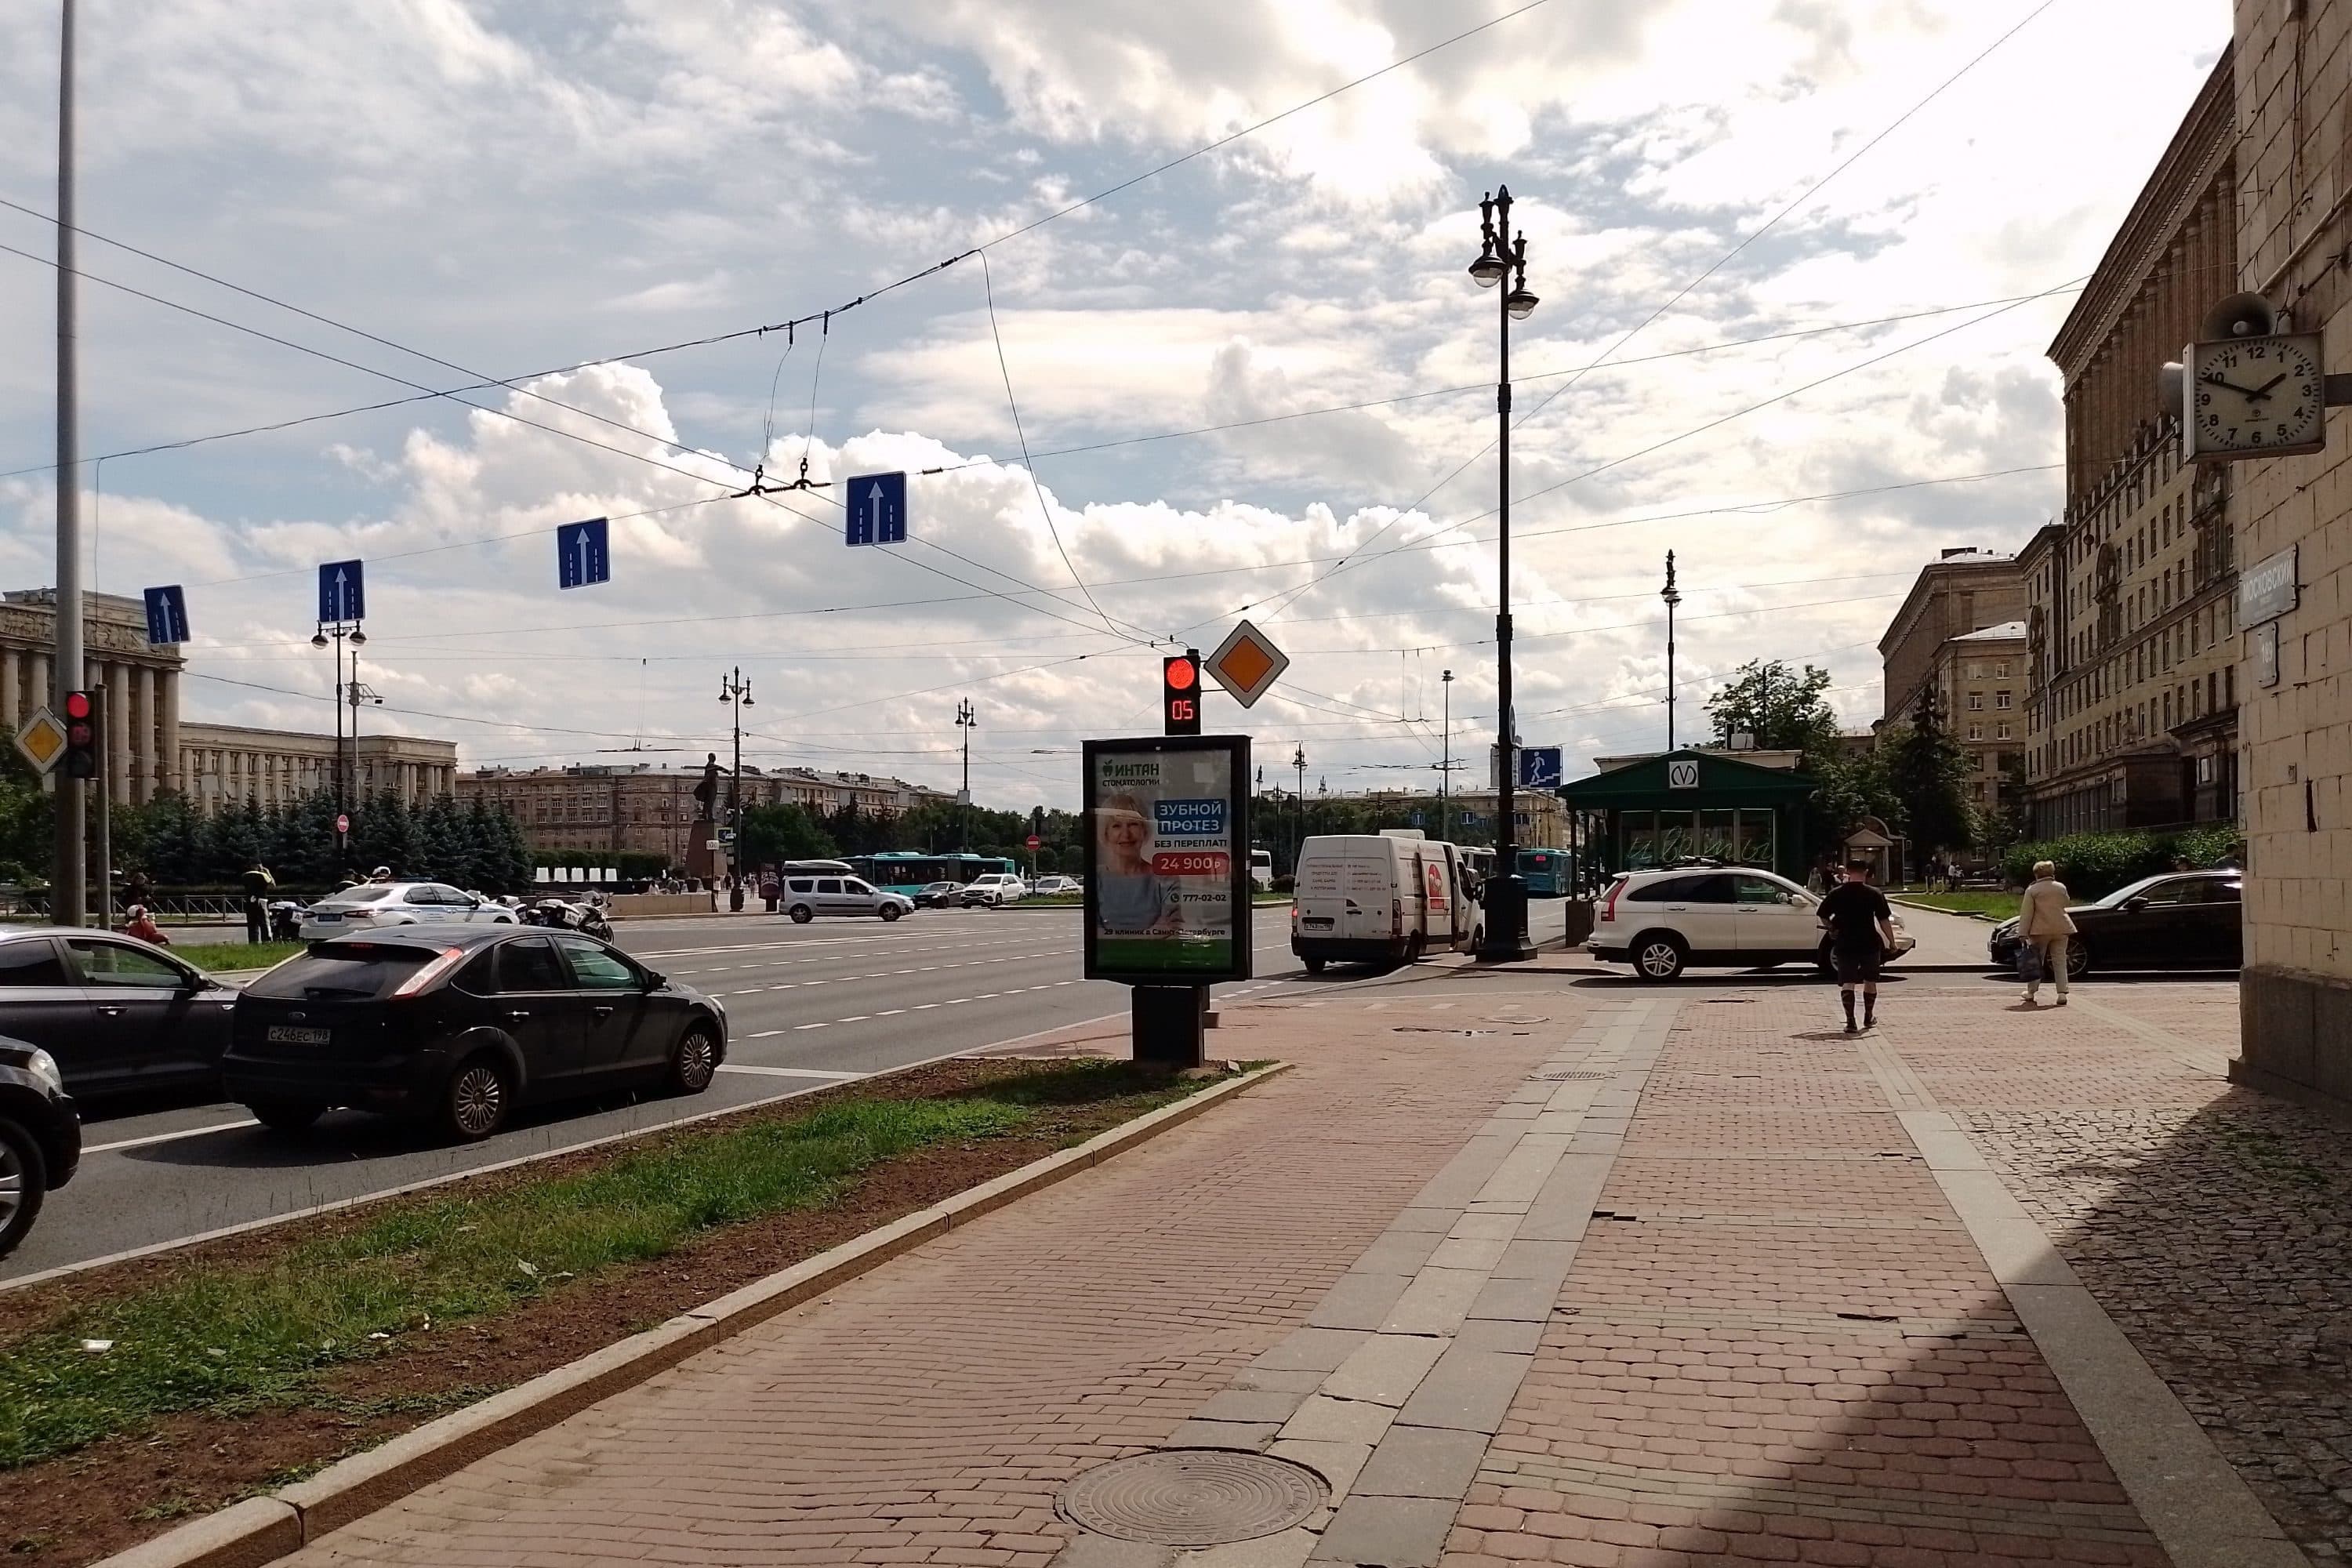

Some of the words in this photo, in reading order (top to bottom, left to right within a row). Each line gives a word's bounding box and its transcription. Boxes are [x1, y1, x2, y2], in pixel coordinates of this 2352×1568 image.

[2247, 347, 2265, 360] 12
[2277, 351, 2284, 363] 1
[2223, 356, 2238, 368] 11
[2294, 365, 2304, 377] 2
[2302, 385, 2312, 397] 3
[2201, 394, 2211, 405] 9
[2294, 406, 2303, 419] 4
[2209, 414, 2219, 426] 8
[2228, 428, 2238, 441] 7
[2277, 424, 2287, 437] 5
[2252, 432, 2261, 444] 6
[2243, 557, 2292, 603] МОСКОВСКИЙ
[1172, 700, 1193, 720] 05
[1116, 763, 1160, 776] ИНТАН
[1102, 779, 1160, 787] СТОМАТОЛОГИИ
[1160, 801, 1222, 816] ЗУБНОЙ
[1160, 819, 1220, 832] ПРОТЕЗ
[1160, 858, 1179, 869] 24
[270, 1028, 310, 1041] С246ЕС
[312, 1029, 328, 1040] 198
